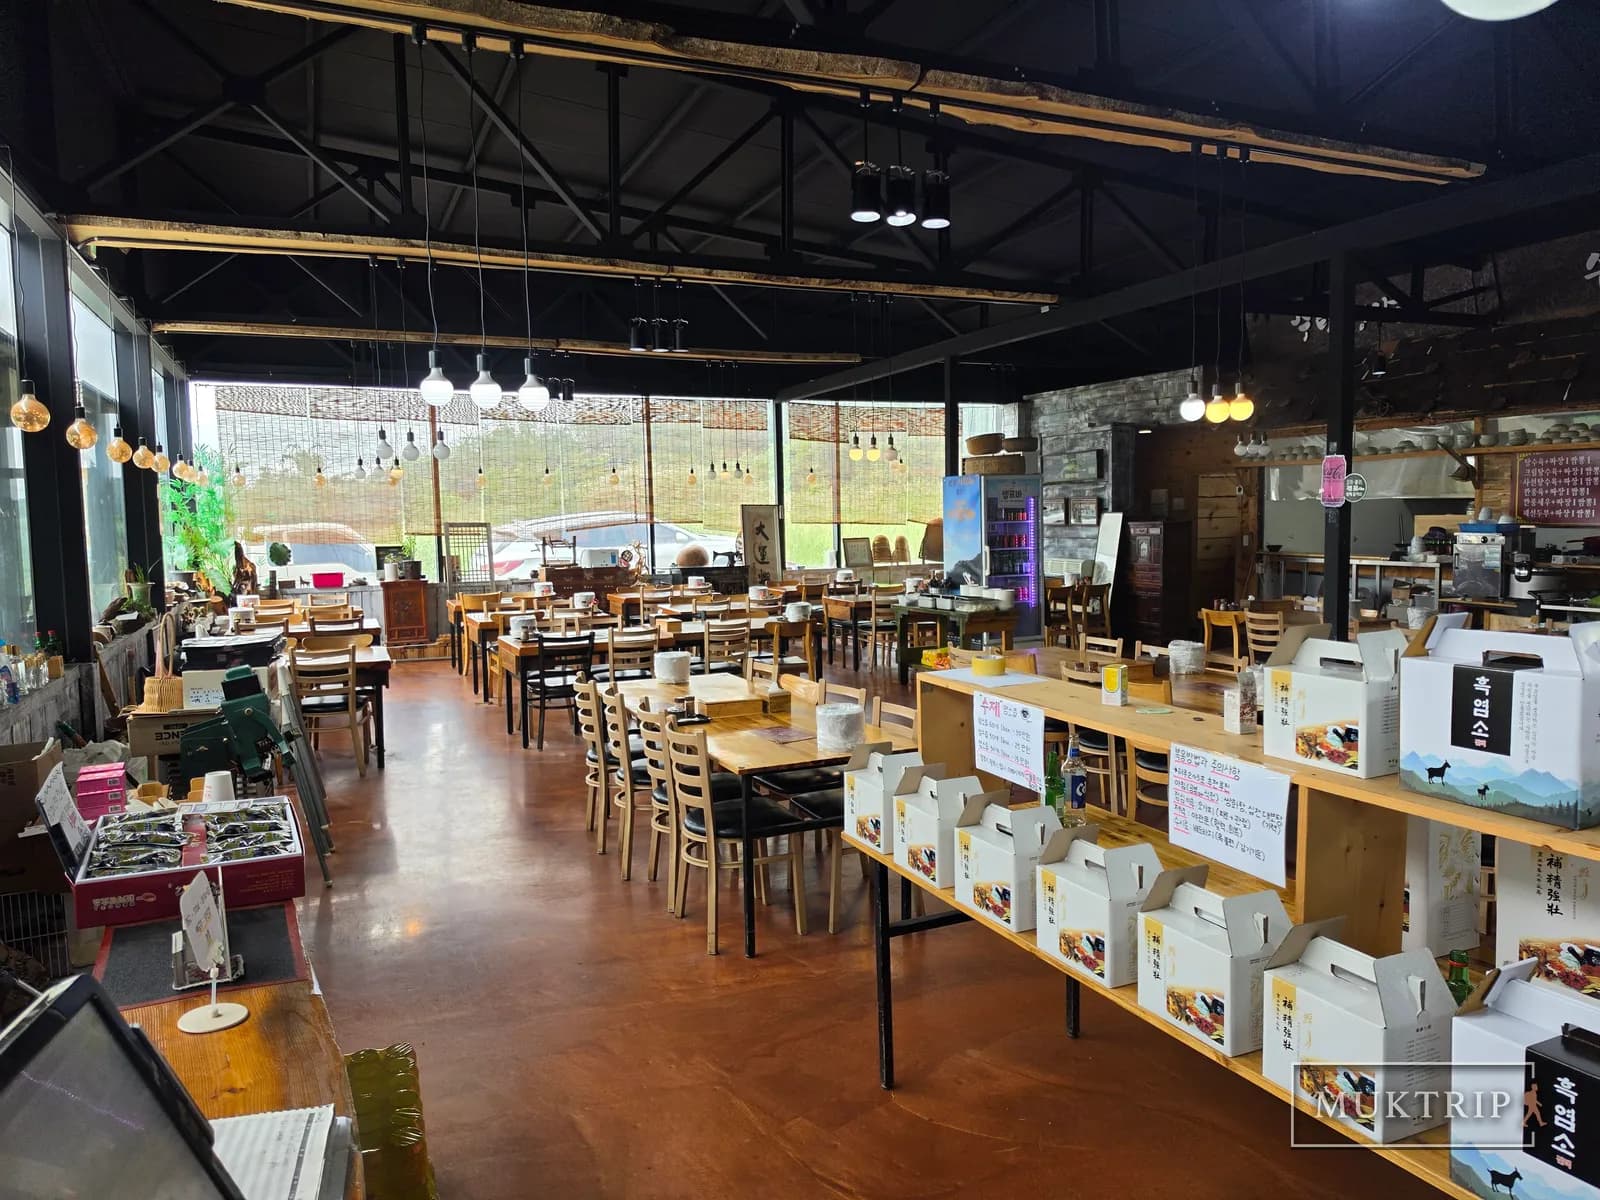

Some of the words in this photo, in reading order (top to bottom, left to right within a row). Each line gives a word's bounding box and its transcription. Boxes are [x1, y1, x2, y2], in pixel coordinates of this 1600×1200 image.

[1470, 675, 1492, 738] 흑염소
[1211, 759, 1240, 781] 주의사항
[1551, 1076, 1579, 1159] 흑염소
